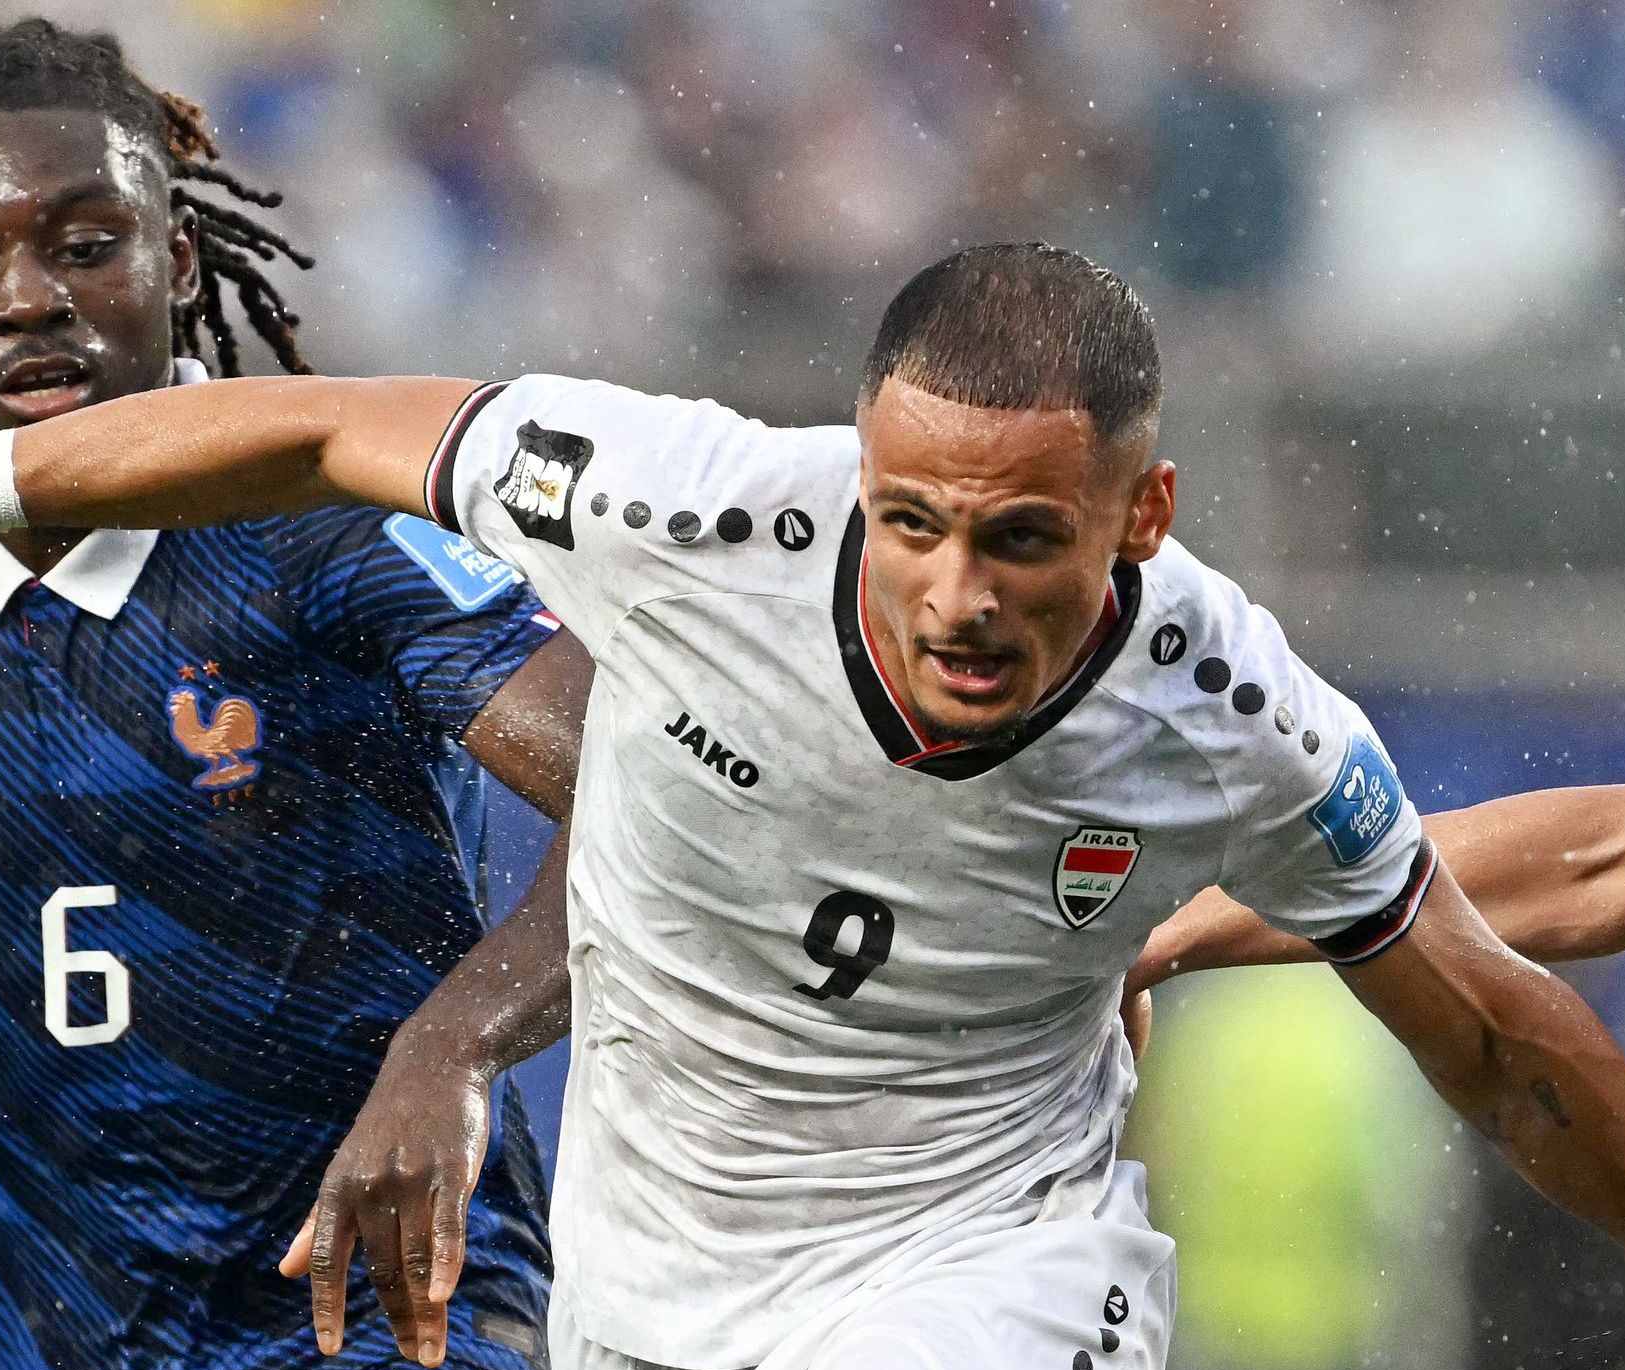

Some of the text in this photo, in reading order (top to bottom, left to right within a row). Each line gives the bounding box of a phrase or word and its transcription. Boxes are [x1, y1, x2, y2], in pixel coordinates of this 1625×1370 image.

[664, 711, 760, 788] JAKO
[1082, 833, 1129, 847] IRAQ
[1357, 787, 1390, 839] PEACE
[1370, 813, 1389, 838] FIFA
[41, 884, 130, 1048] 6
[792, 890, 895, 1001] 9
